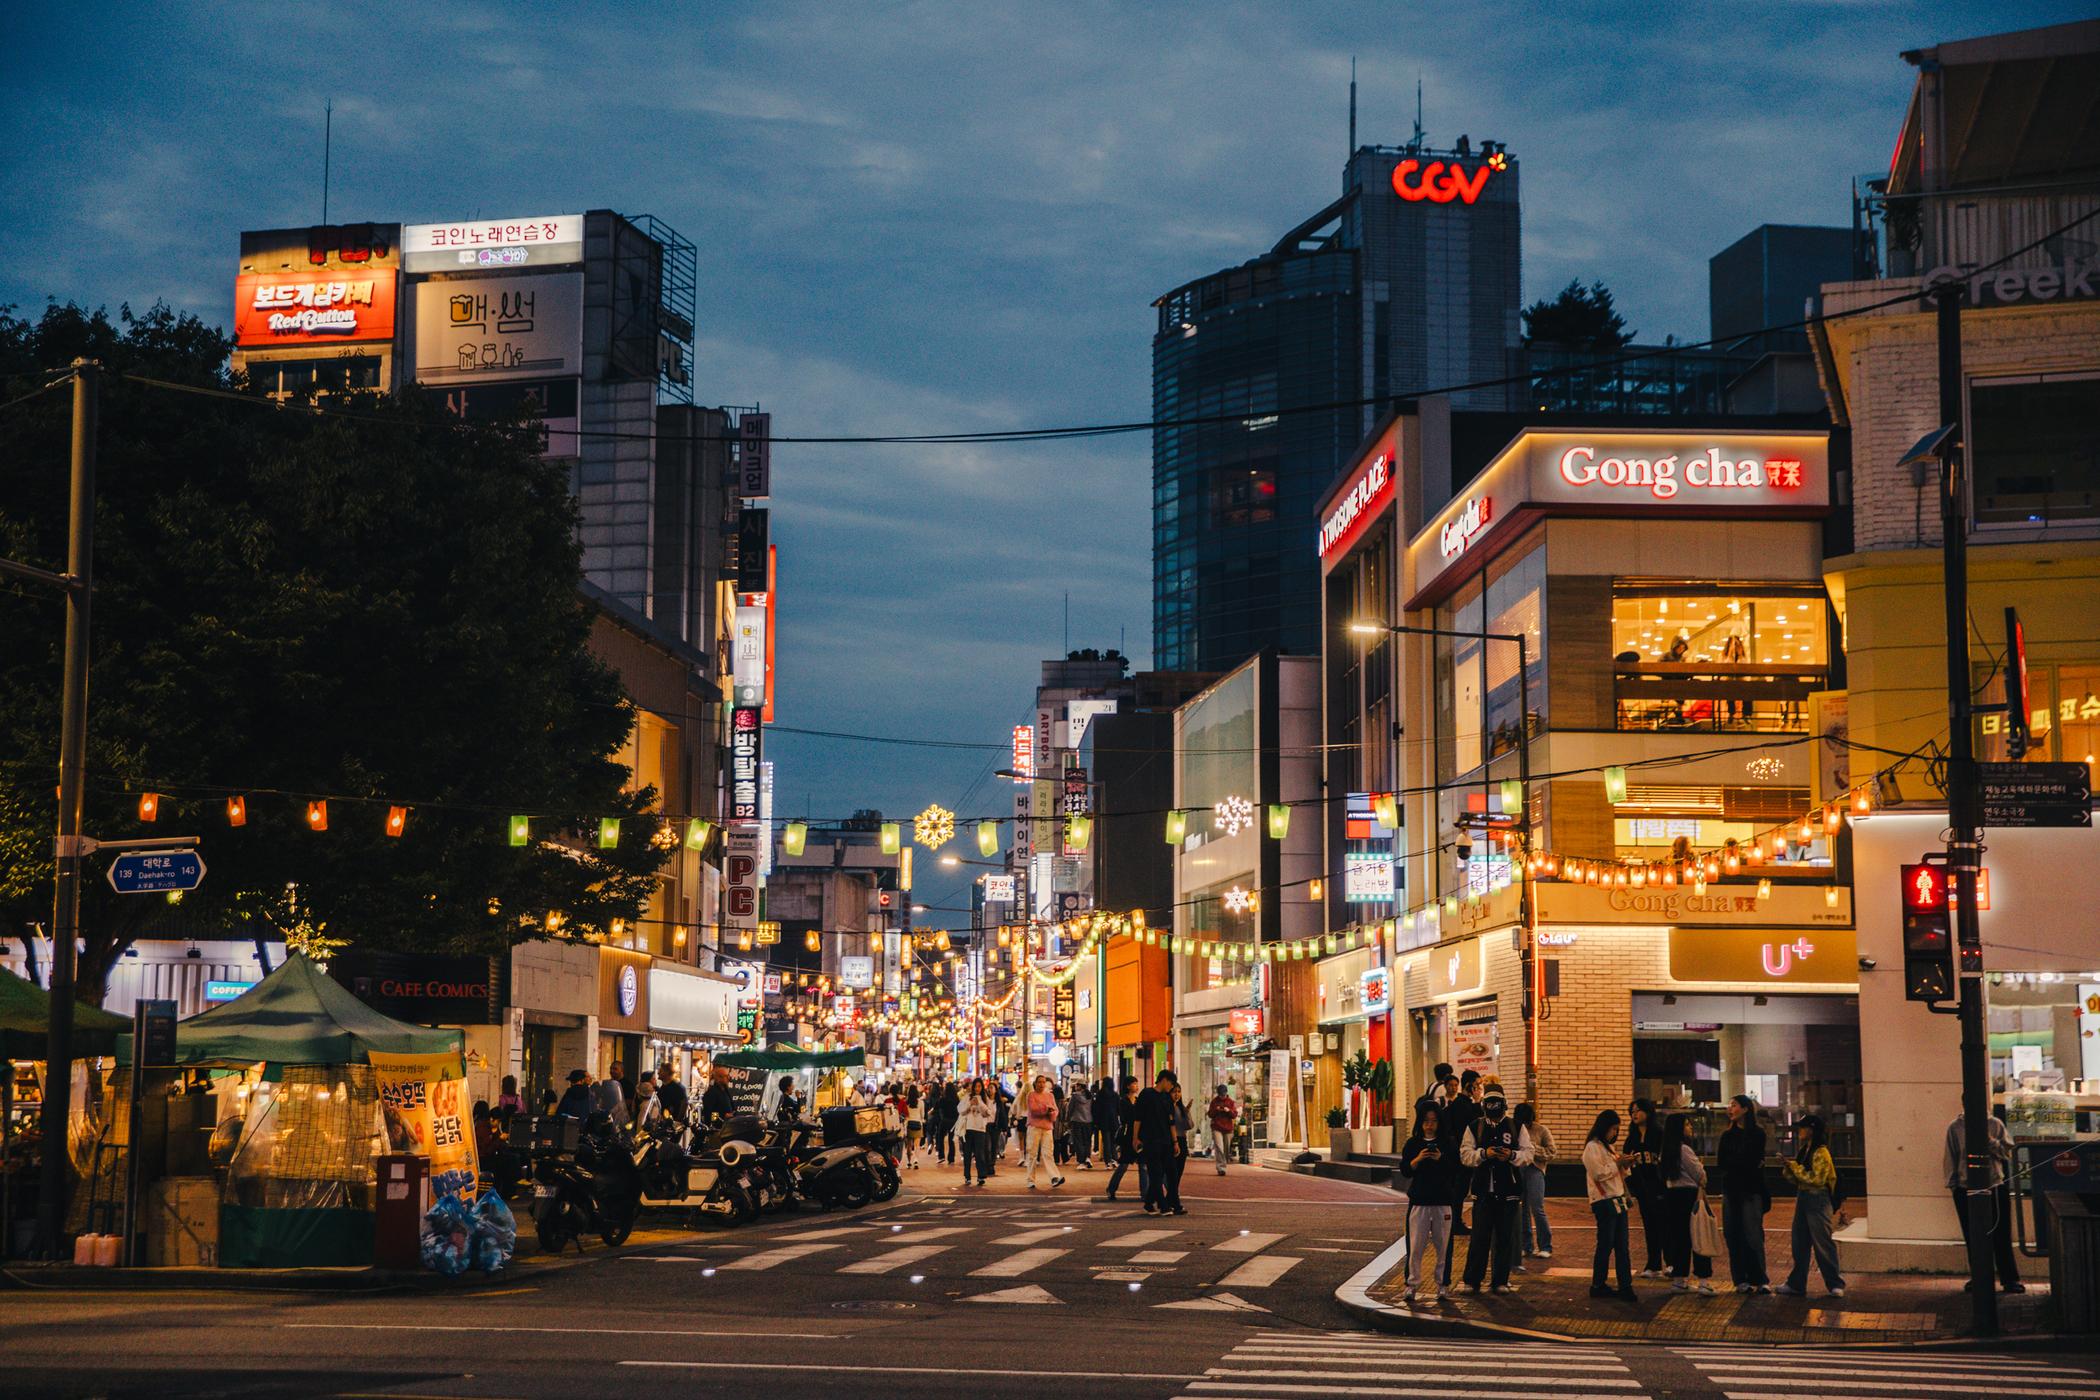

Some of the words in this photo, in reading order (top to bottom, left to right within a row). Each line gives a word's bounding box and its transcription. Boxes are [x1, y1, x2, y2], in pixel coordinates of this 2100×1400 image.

[1392, 159, 1490, 204] CGV
[252, 281, 374, 308] 보드게임카페
[1560, 446, 1679, 500] Gong
[1685, 448, 1763, 487] cha
[1318, 531, 1325, 558] A
[1323, 487, 1360, 548] TWOSOME
[1358, 455, 1386, 509] PLACE
[1041, 713, 1050, 763] ARTBOX
[733, 733, 757, 804] 방탈출
[735, 805, 755, 817] B2
[120, 869, 132, 879] 139
[138, 871, 176, 880] Daehak-ro
[143, 857, 172, 869] 대학로
[182, 865, 195, 875] 143
[728, 855, 755, 917] PC
[1609, 888, 1681, 919] Gong
[1685, 889, 1733, 913] cha
[1762, 937, 1814, 976] U+
[380, 978, 423, 998] CAFE
[424, 979, 488, 999] COMICS
[1056, 983, 1073, 1037] 노래방
[1502, 1132, 1512, 1144] S
